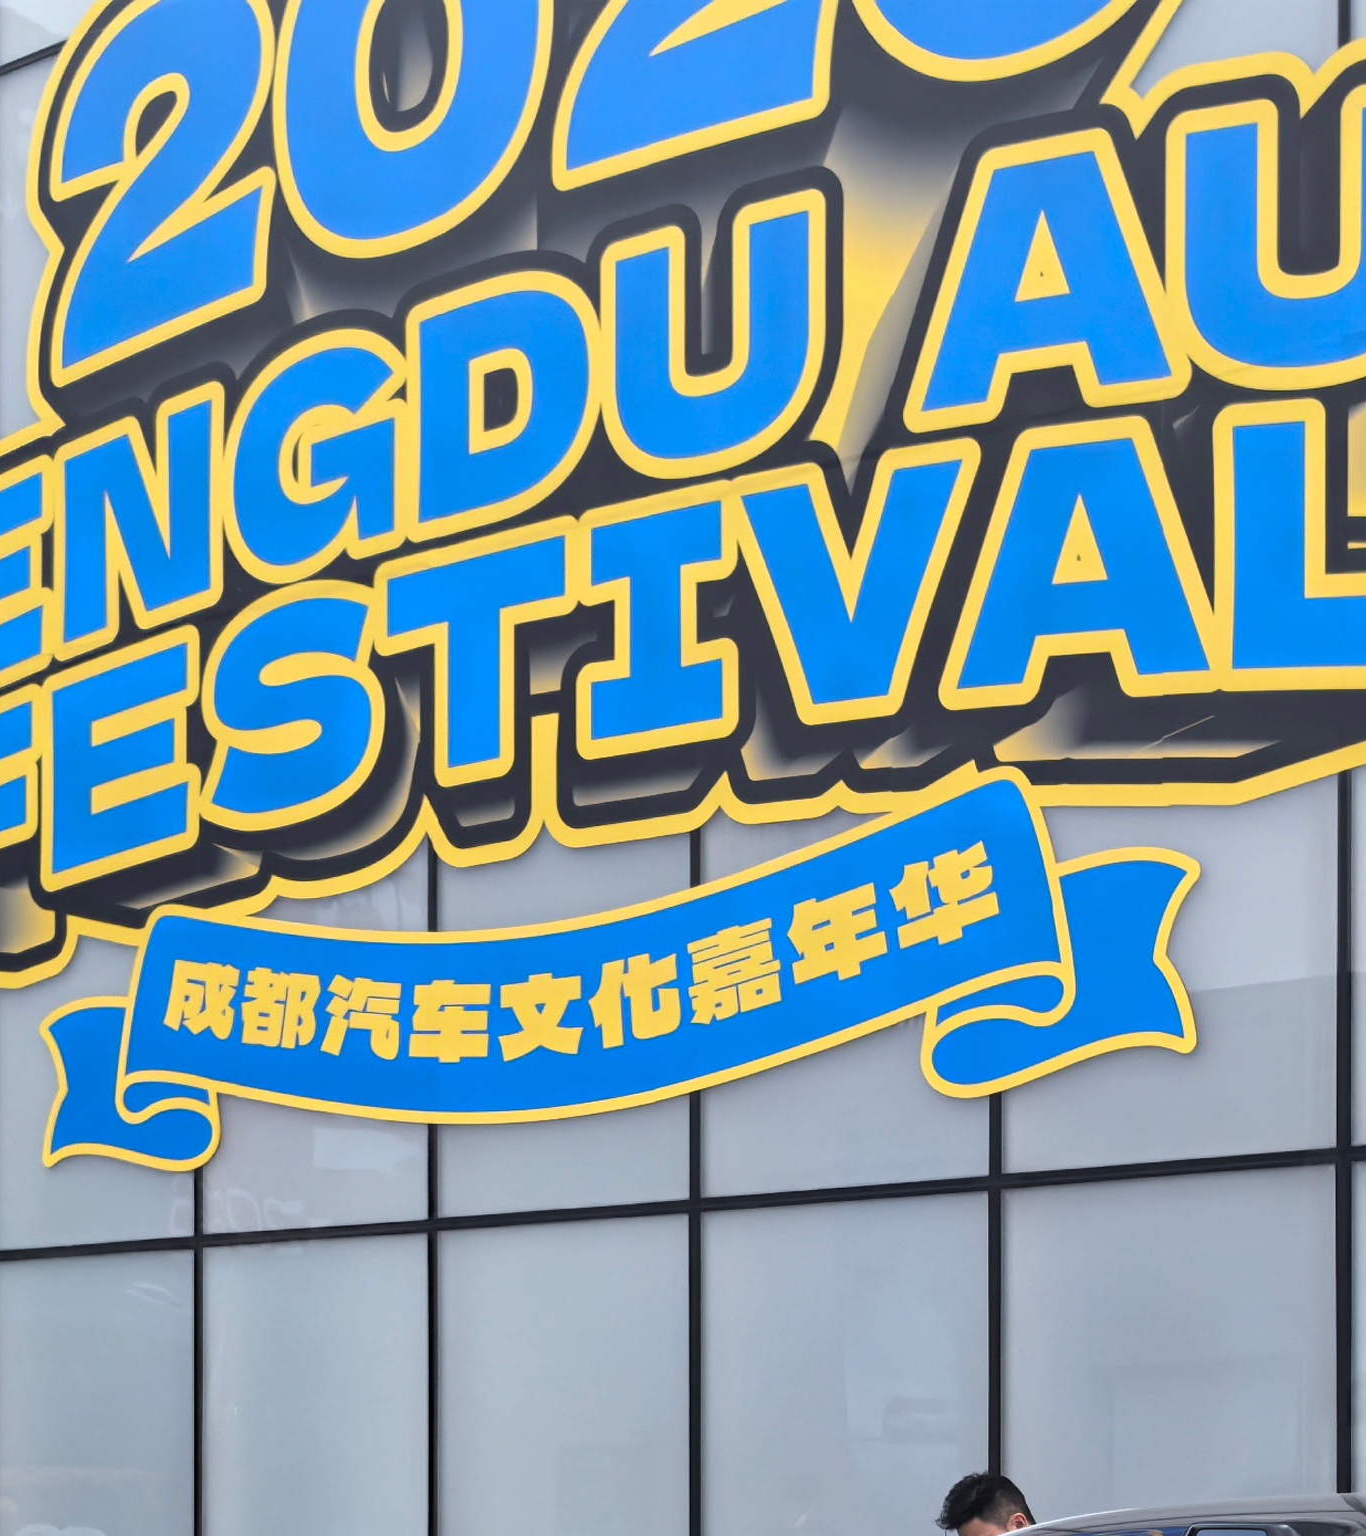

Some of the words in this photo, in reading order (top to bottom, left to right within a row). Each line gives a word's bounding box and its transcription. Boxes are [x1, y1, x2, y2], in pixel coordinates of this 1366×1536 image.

[51, 0, 1147, 386] 20
[163, 841, 999, 1063] 成都汽车文化嘉年华
